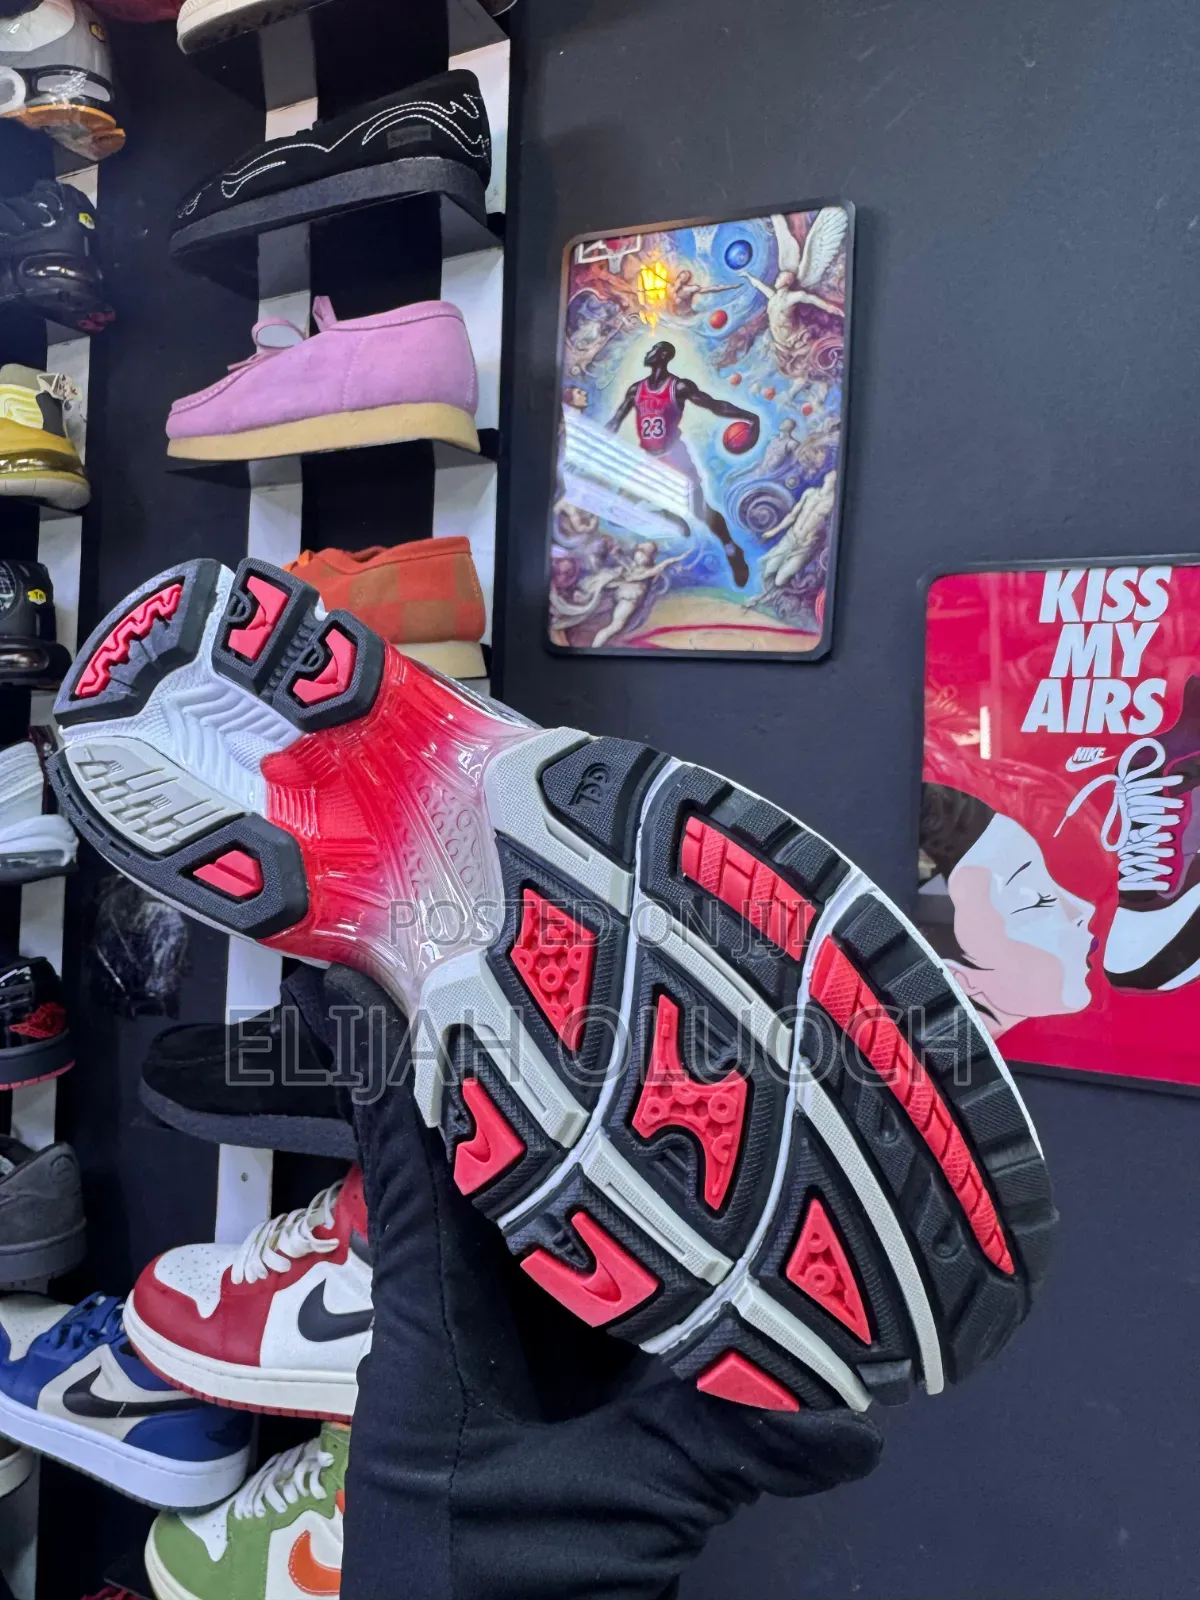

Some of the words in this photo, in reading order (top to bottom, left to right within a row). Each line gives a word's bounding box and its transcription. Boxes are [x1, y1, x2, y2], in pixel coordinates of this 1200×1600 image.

[641, 416, 666, 440] 23
[1039, 566, 1172, 623] KISS
[1049, 622, 1159, 678] MY
[1020, 678, 1167, 735] AIRS
[1072, 746, 1106, 762] NIKE
